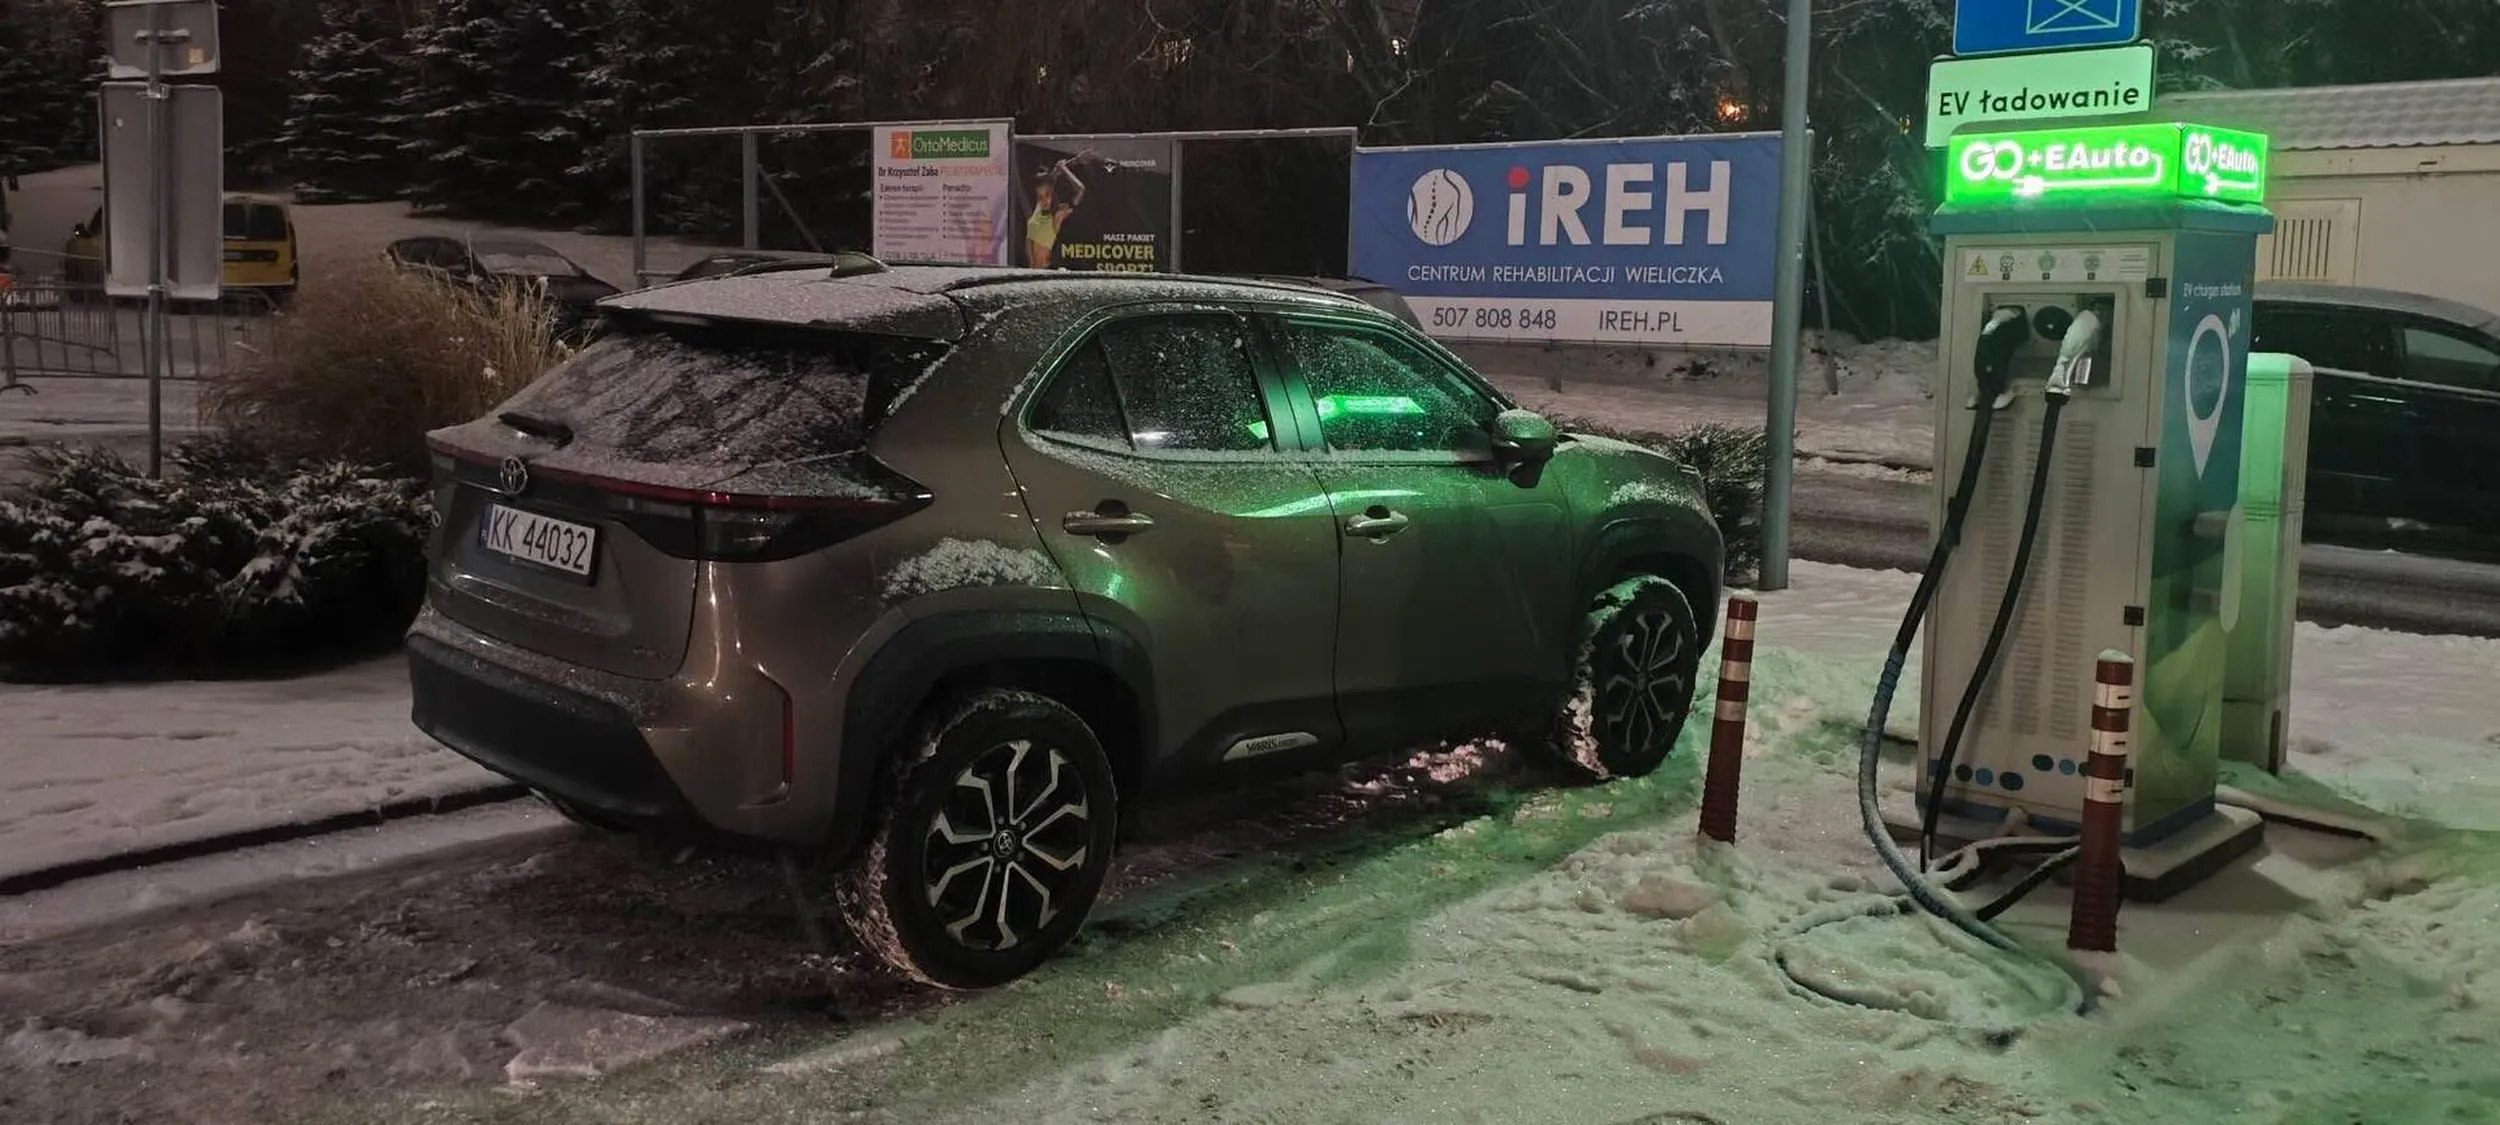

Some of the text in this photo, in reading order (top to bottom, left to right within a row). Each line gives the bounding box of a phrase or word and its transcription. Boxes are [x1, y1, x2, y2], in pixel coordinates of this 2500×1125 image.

[1939, 81, 2139, 116] EV ładowanie
[913, 136, 988, 153] OrtoMedicus
[879, 167, 886, 177] Dr
[888, 166, 920, 179] Krzysztof
[1507, 160, 1731, 246] iREH
[1103, 234, 1156, 242] MASZ PAKIET
[1061, 243, 1154, 260] MEDICOVER
[1407, 265, 1724, 285] CENTRUM REHABILITACJI WIELICZKA
[1432, 308, 1557, 330] 507 808 848
[1600, 310, 1683, 332] IREH.PL
[490, 508, 588, 571] KK 44032
